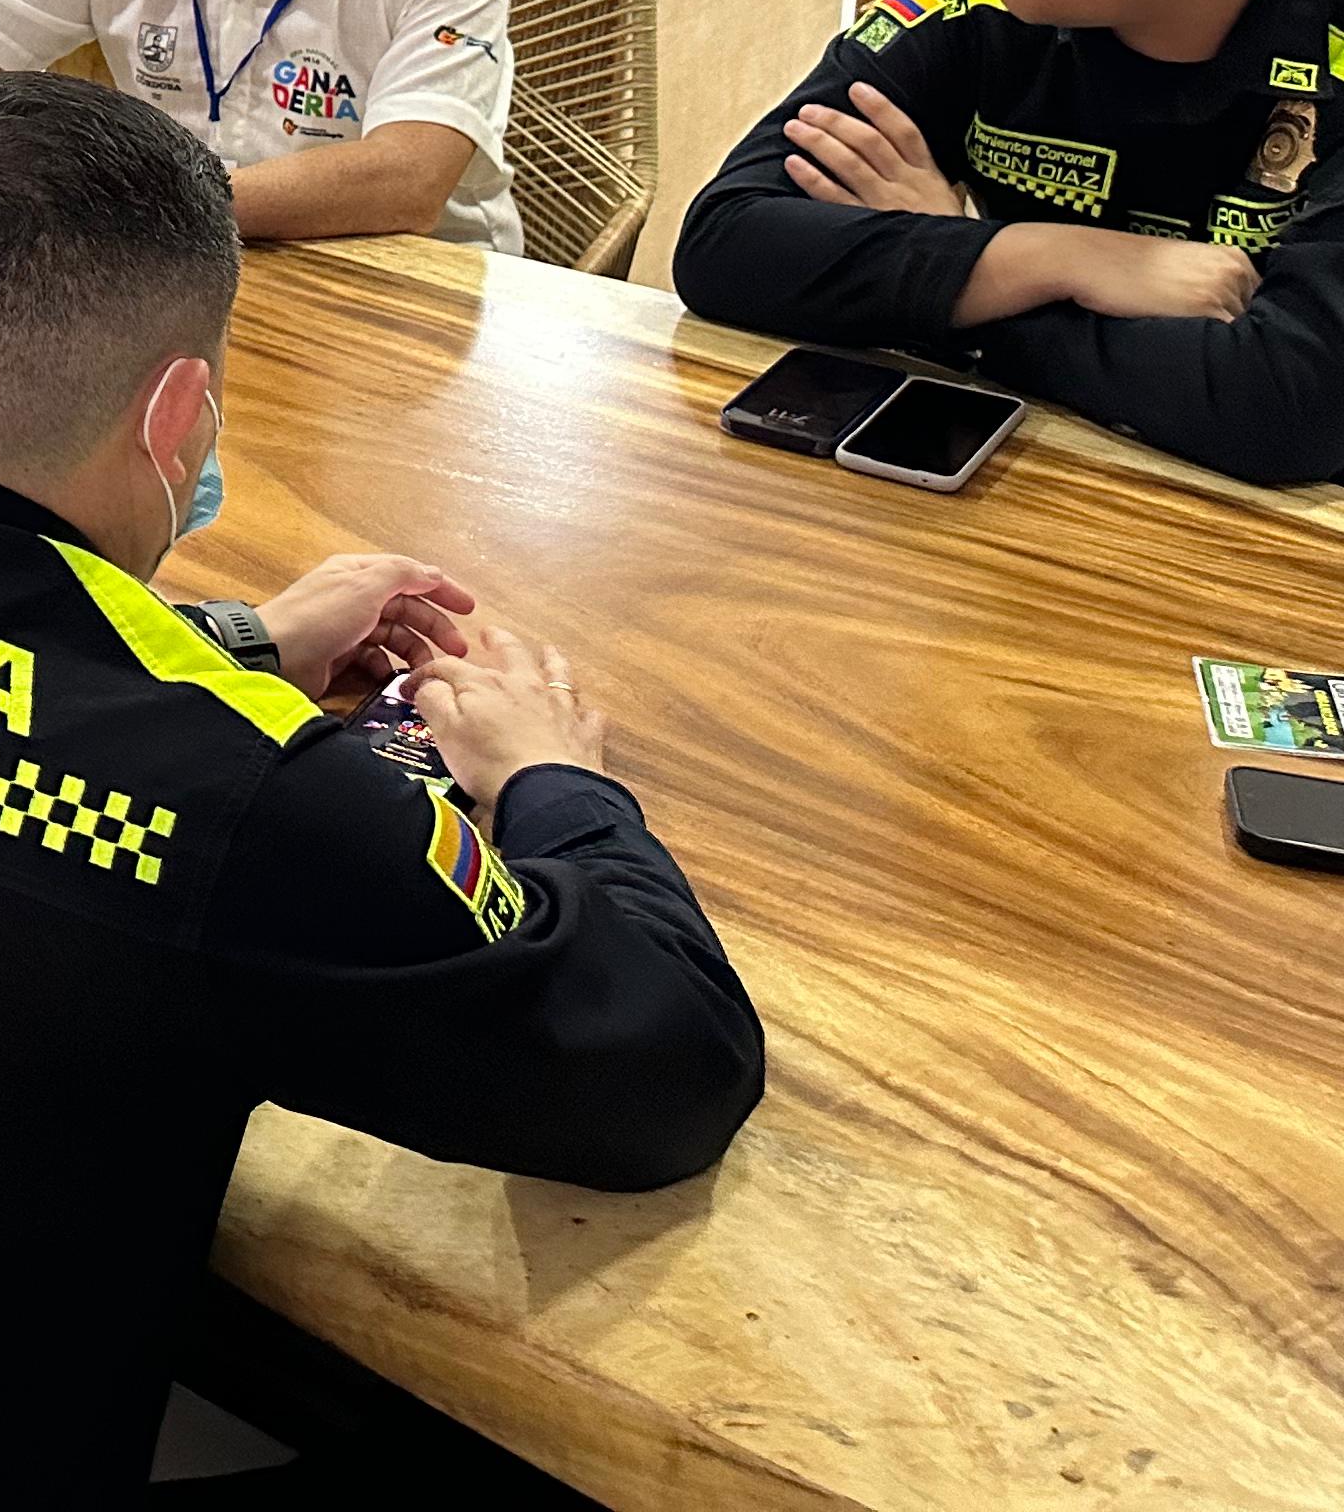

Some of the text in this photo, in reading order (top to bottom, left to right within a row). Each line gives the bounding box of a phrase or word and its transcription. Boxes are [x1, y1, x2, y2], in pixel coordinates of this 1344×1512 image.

[274, 60, 356, 98] GANA
[975, 126, 1097, 168] Teniente Coronel
[1038, 162, 1101, 190] DIAZ
